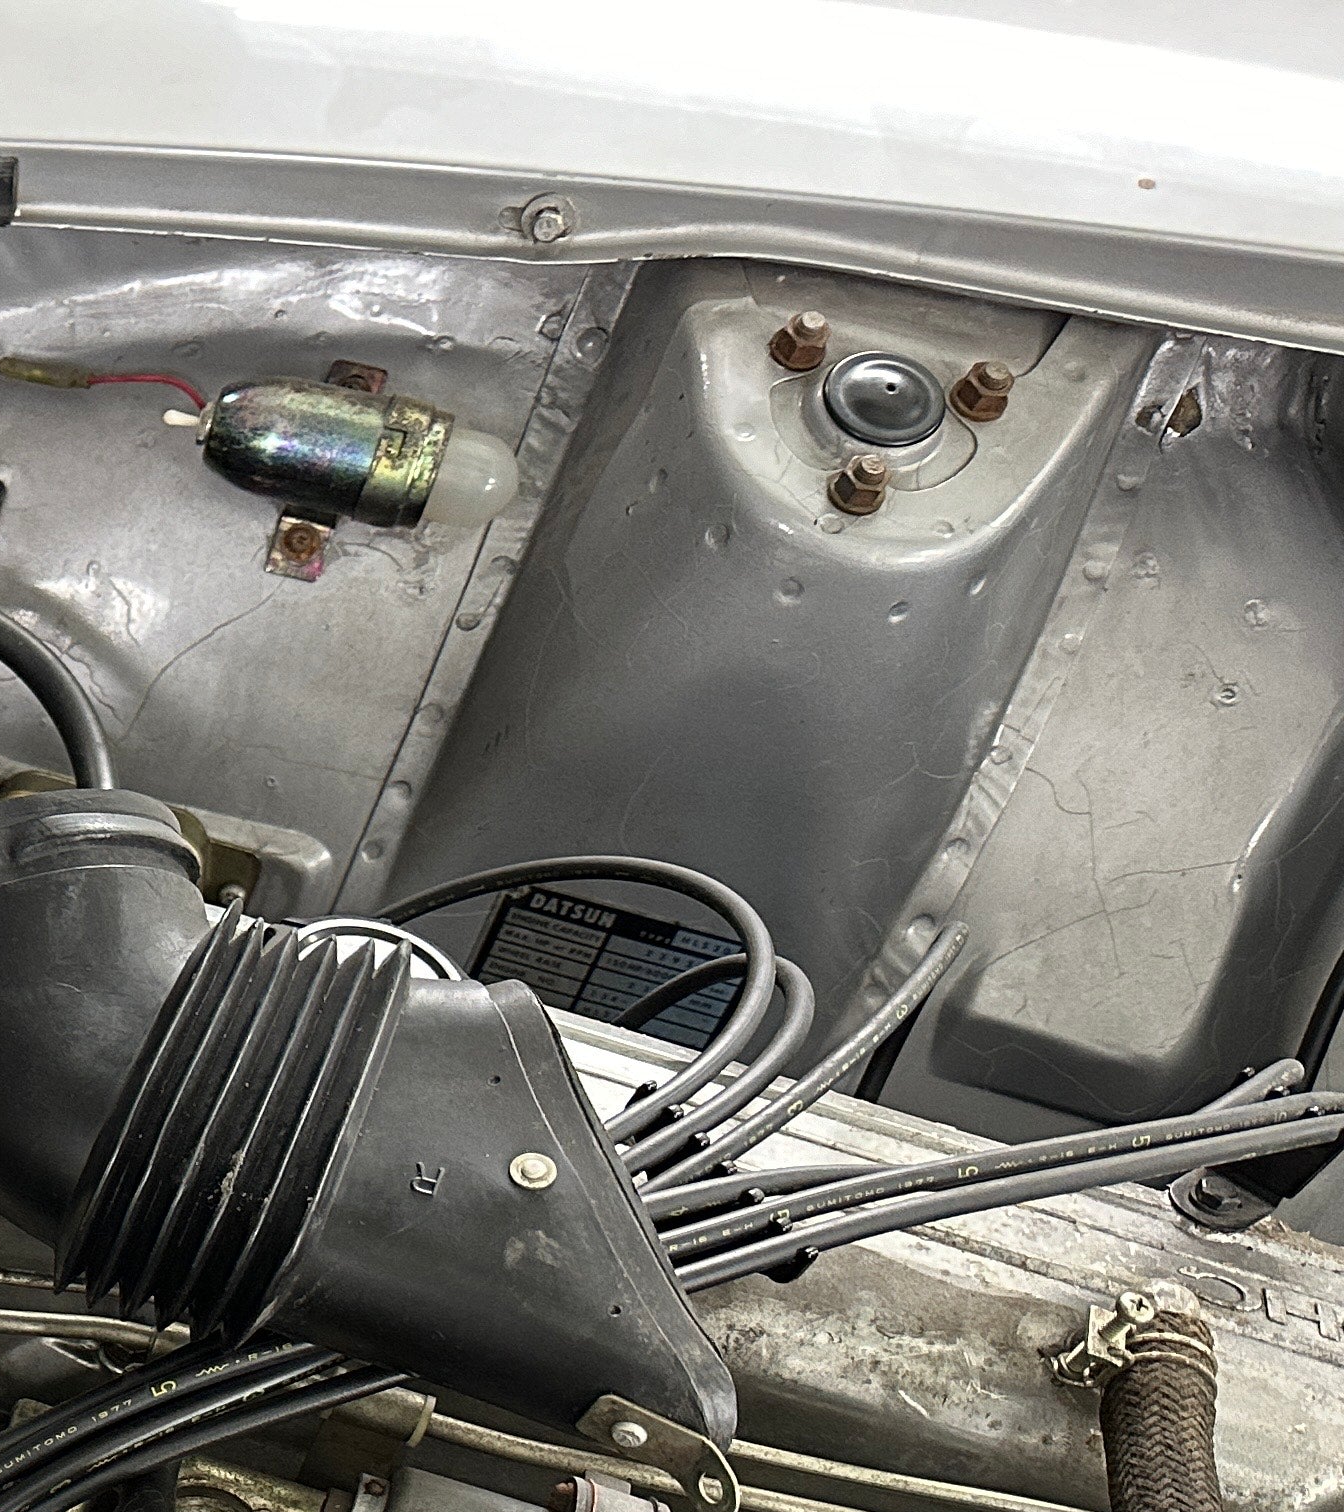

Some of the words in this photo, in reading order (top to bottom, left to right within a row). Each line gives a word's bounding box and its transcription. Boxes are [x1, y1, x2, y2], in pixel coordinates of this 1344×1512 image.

[528, 891, 616, 929] DATSUN
[806, 1187, 886, 1212] SUMITOMO
[897, 1176, 936, 1190] 1977
[957, 1165, 979, 1179] 5
[1132, 1134, 1151, 1148] 5
[1165, 1124, 1231, 1140] SUMITOMO
[92, 1399, 132, 1423] 1977
[150, 1380, 177, 1398] 5
